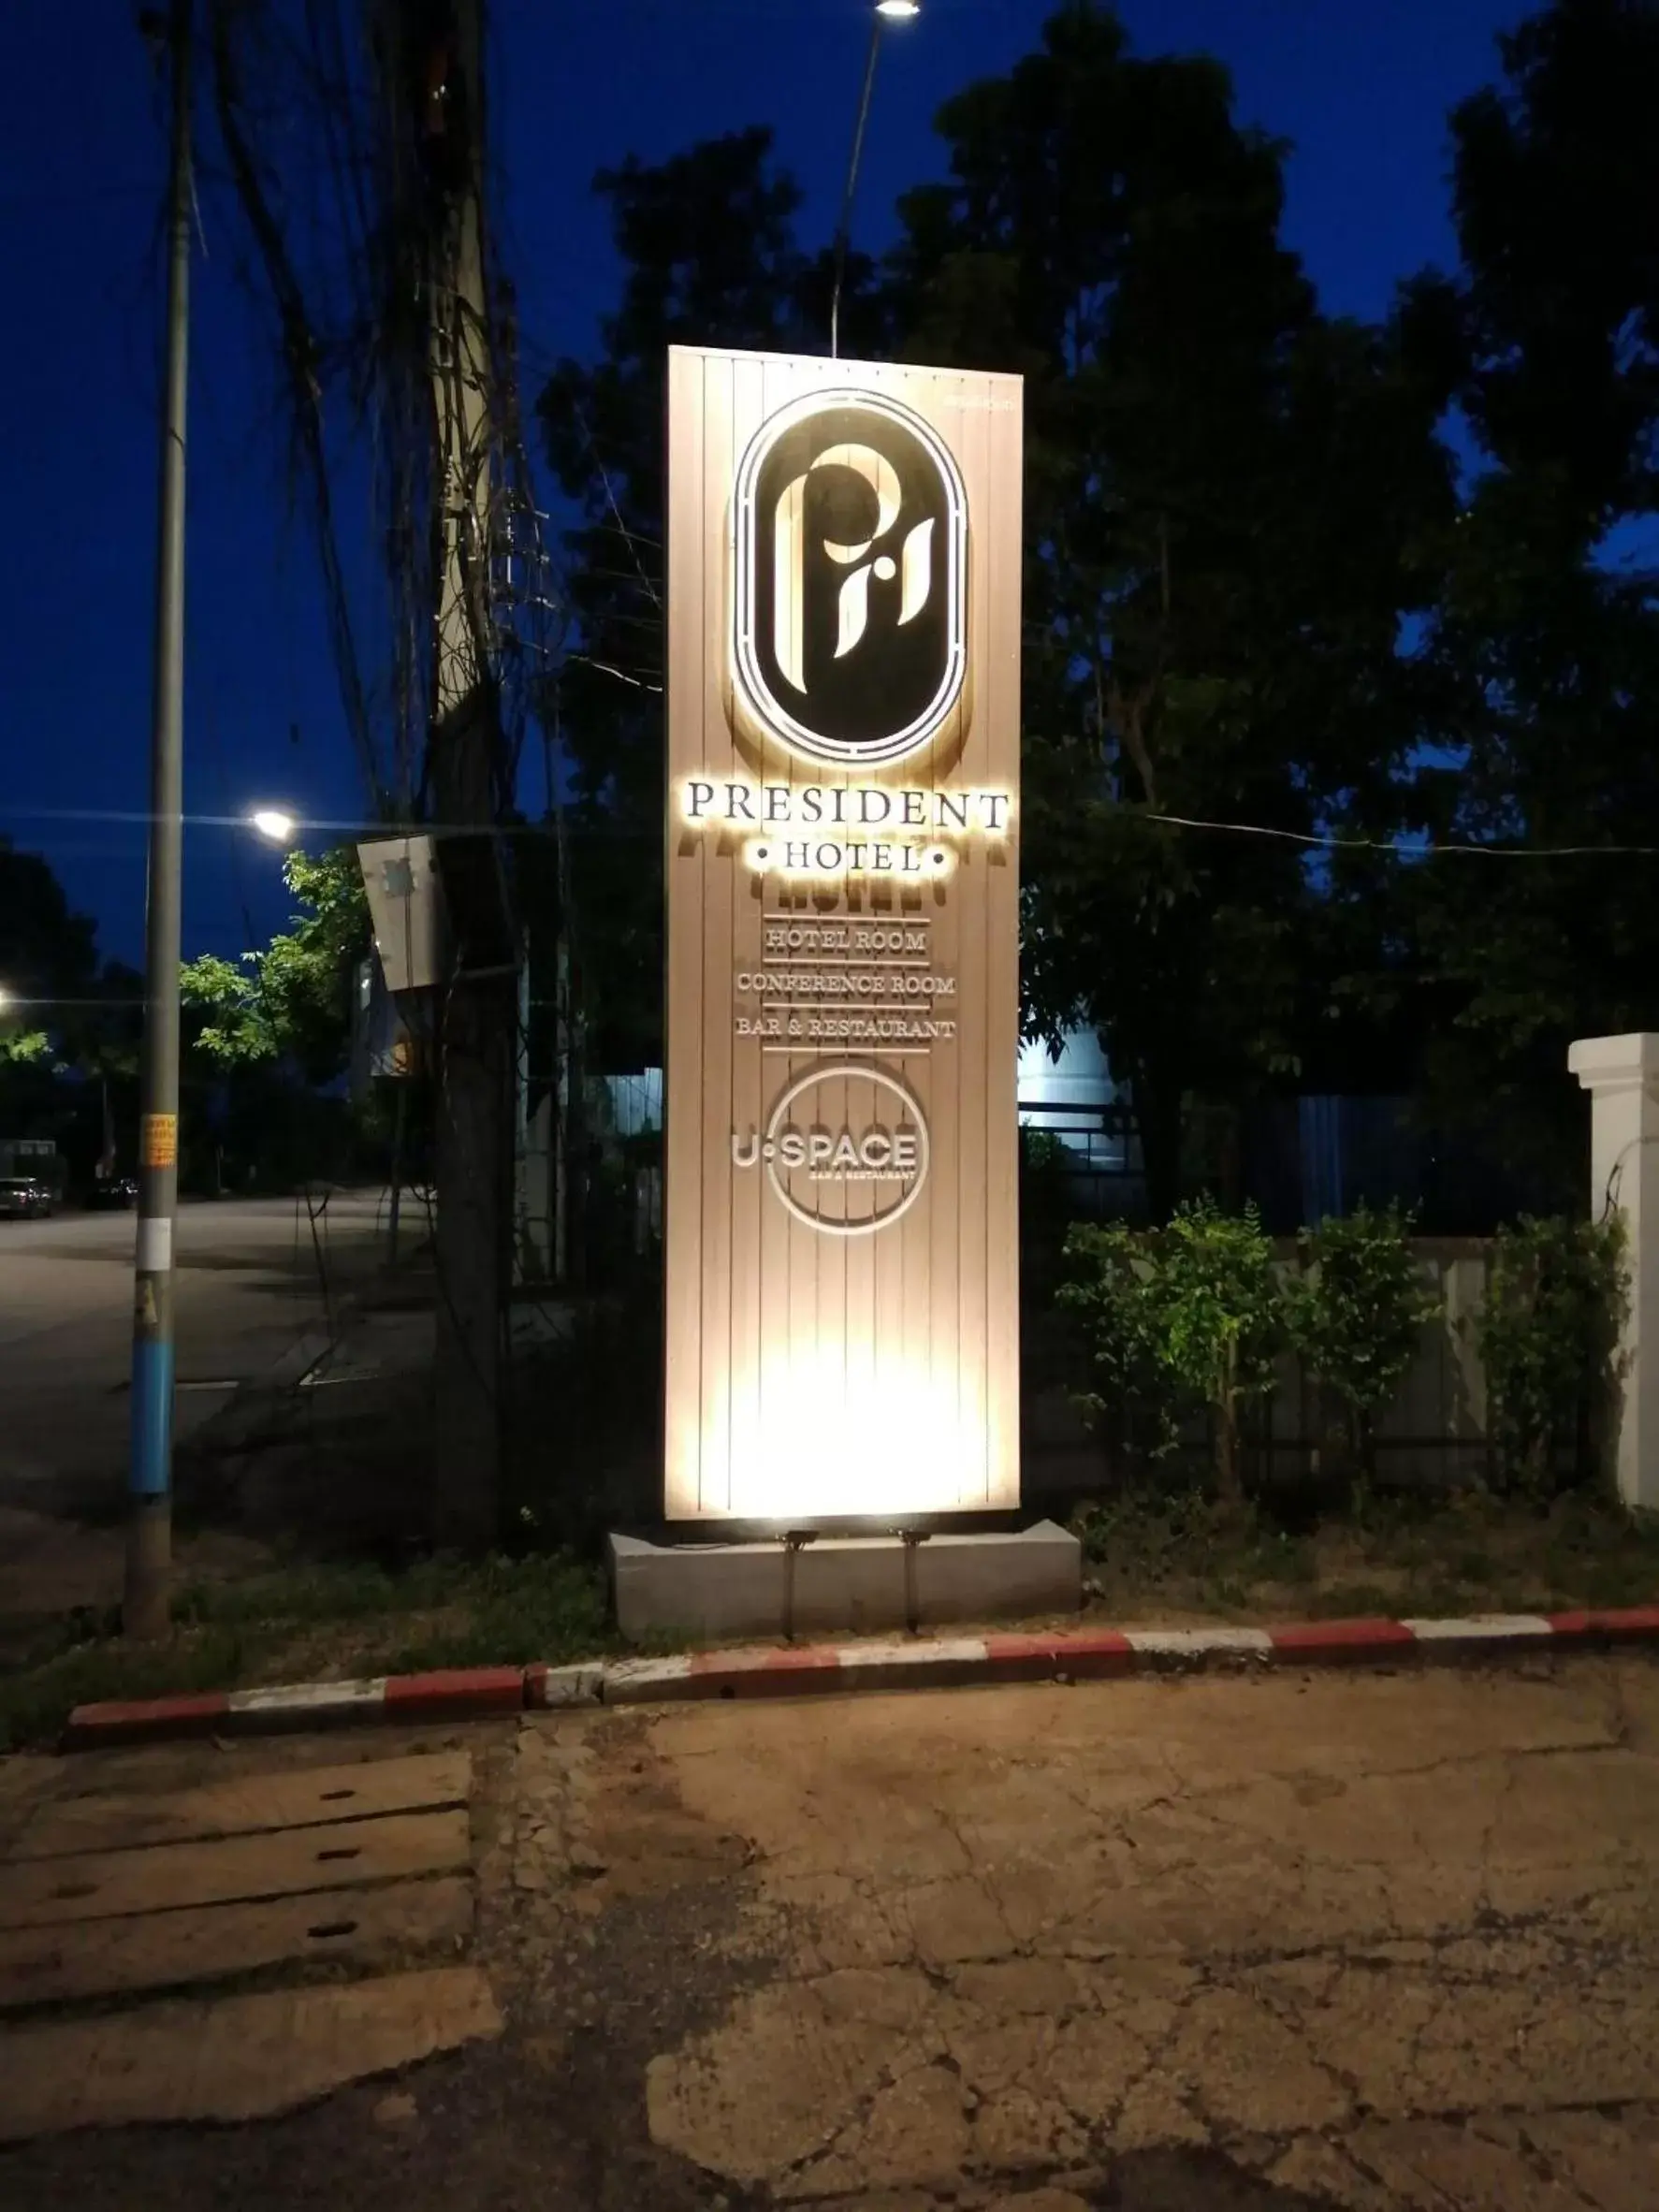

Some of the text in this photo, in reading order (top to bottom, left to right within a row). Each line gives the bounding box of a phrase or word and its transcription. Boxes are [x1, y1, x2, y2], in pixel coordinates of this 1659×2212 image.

[688, 782, 1009, 828] PRESIDENT
[786, 841, 921, 871] HOTEL
[765, 929, 926, 951] HOTEL ROOM
[737, 973, 956, 995] CONFERENCE ROOM
[736, 1017, 957, 1038] BAR & RESTAURANT
